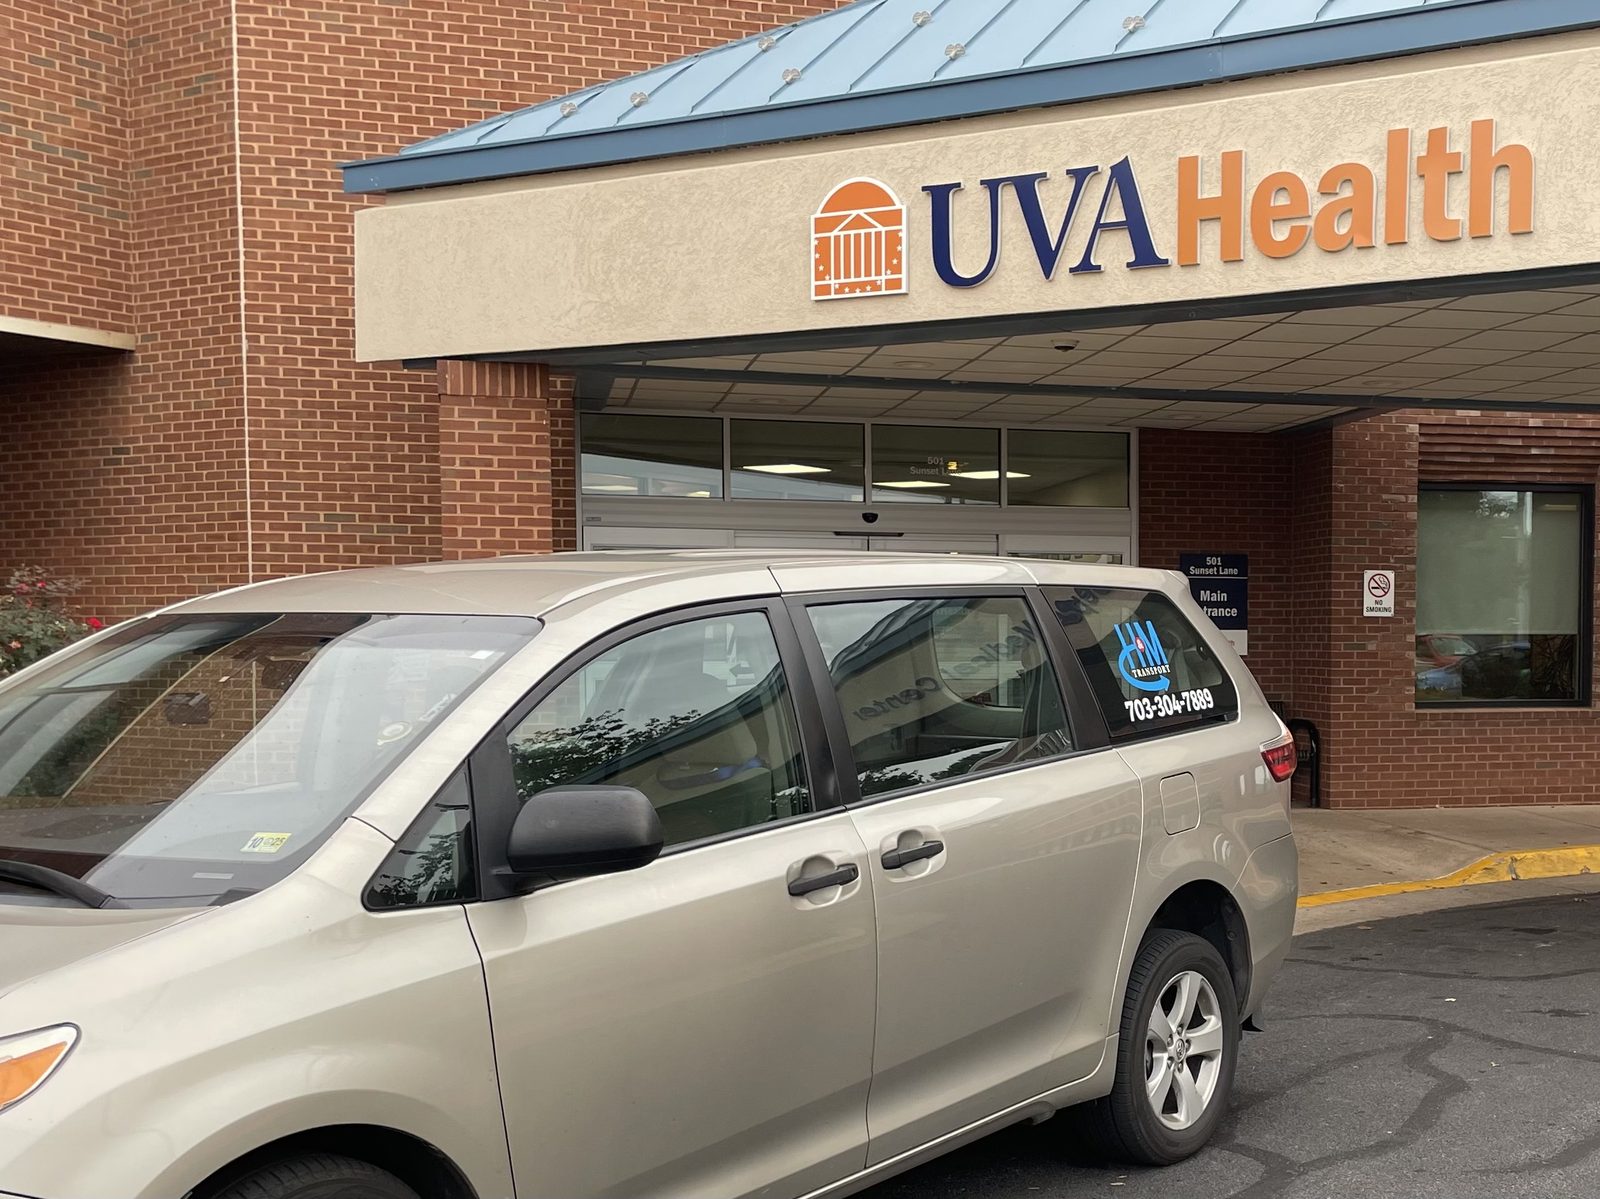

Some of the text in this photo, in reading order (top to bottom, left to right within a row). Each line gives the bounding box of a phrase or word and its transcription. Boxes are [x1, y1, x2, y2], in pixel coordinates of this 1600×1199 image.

[921, 118, 1535, 289] UVA Health
[927, 457, 944, 465] 501
[910, 466, 939, 475] Sunset
[1206, 556, 1222, 565] 501
[1189, 566, 1239, 575] Sunset Lane
[1200, 590, 1228, 602] Main
[1202, 606, 1238, 617] trance
[1131, 664, 1171, 678] TRANSPORT
[1124, 687, 1214, 722] 703-304-7889
[248, 837, 264, 849] 10
